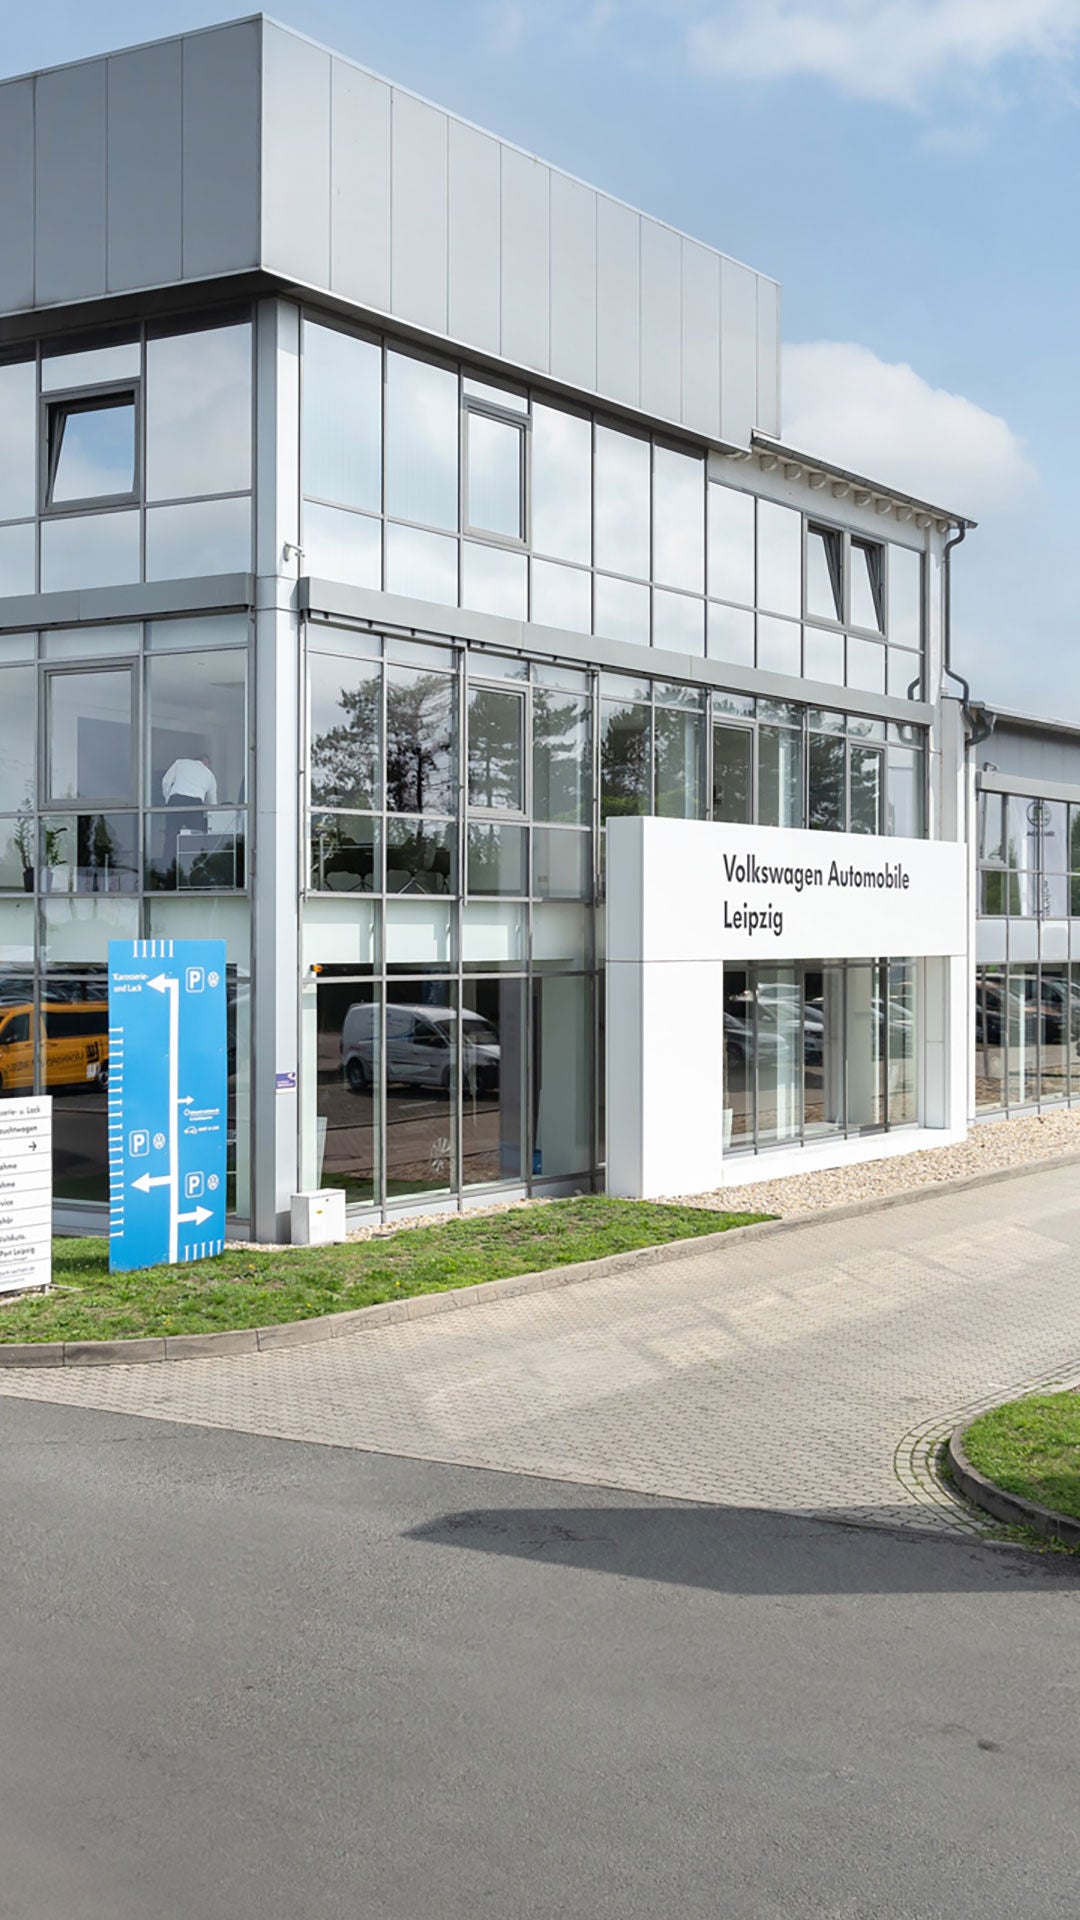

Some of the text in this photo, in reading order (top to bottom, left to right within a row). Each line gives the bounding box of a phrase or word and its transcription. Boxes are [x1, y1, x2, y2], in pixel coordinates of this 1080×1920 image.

[723, 854, 910, 892] Volkswagen Automobile
[724, 900, 783, 936] Leipzig
[127, 984, 142, 992] Lack
[189, 970, 201, 989] P
[133, 1133, 145, 1153] P
[189, 1175, 200, 1194] P
